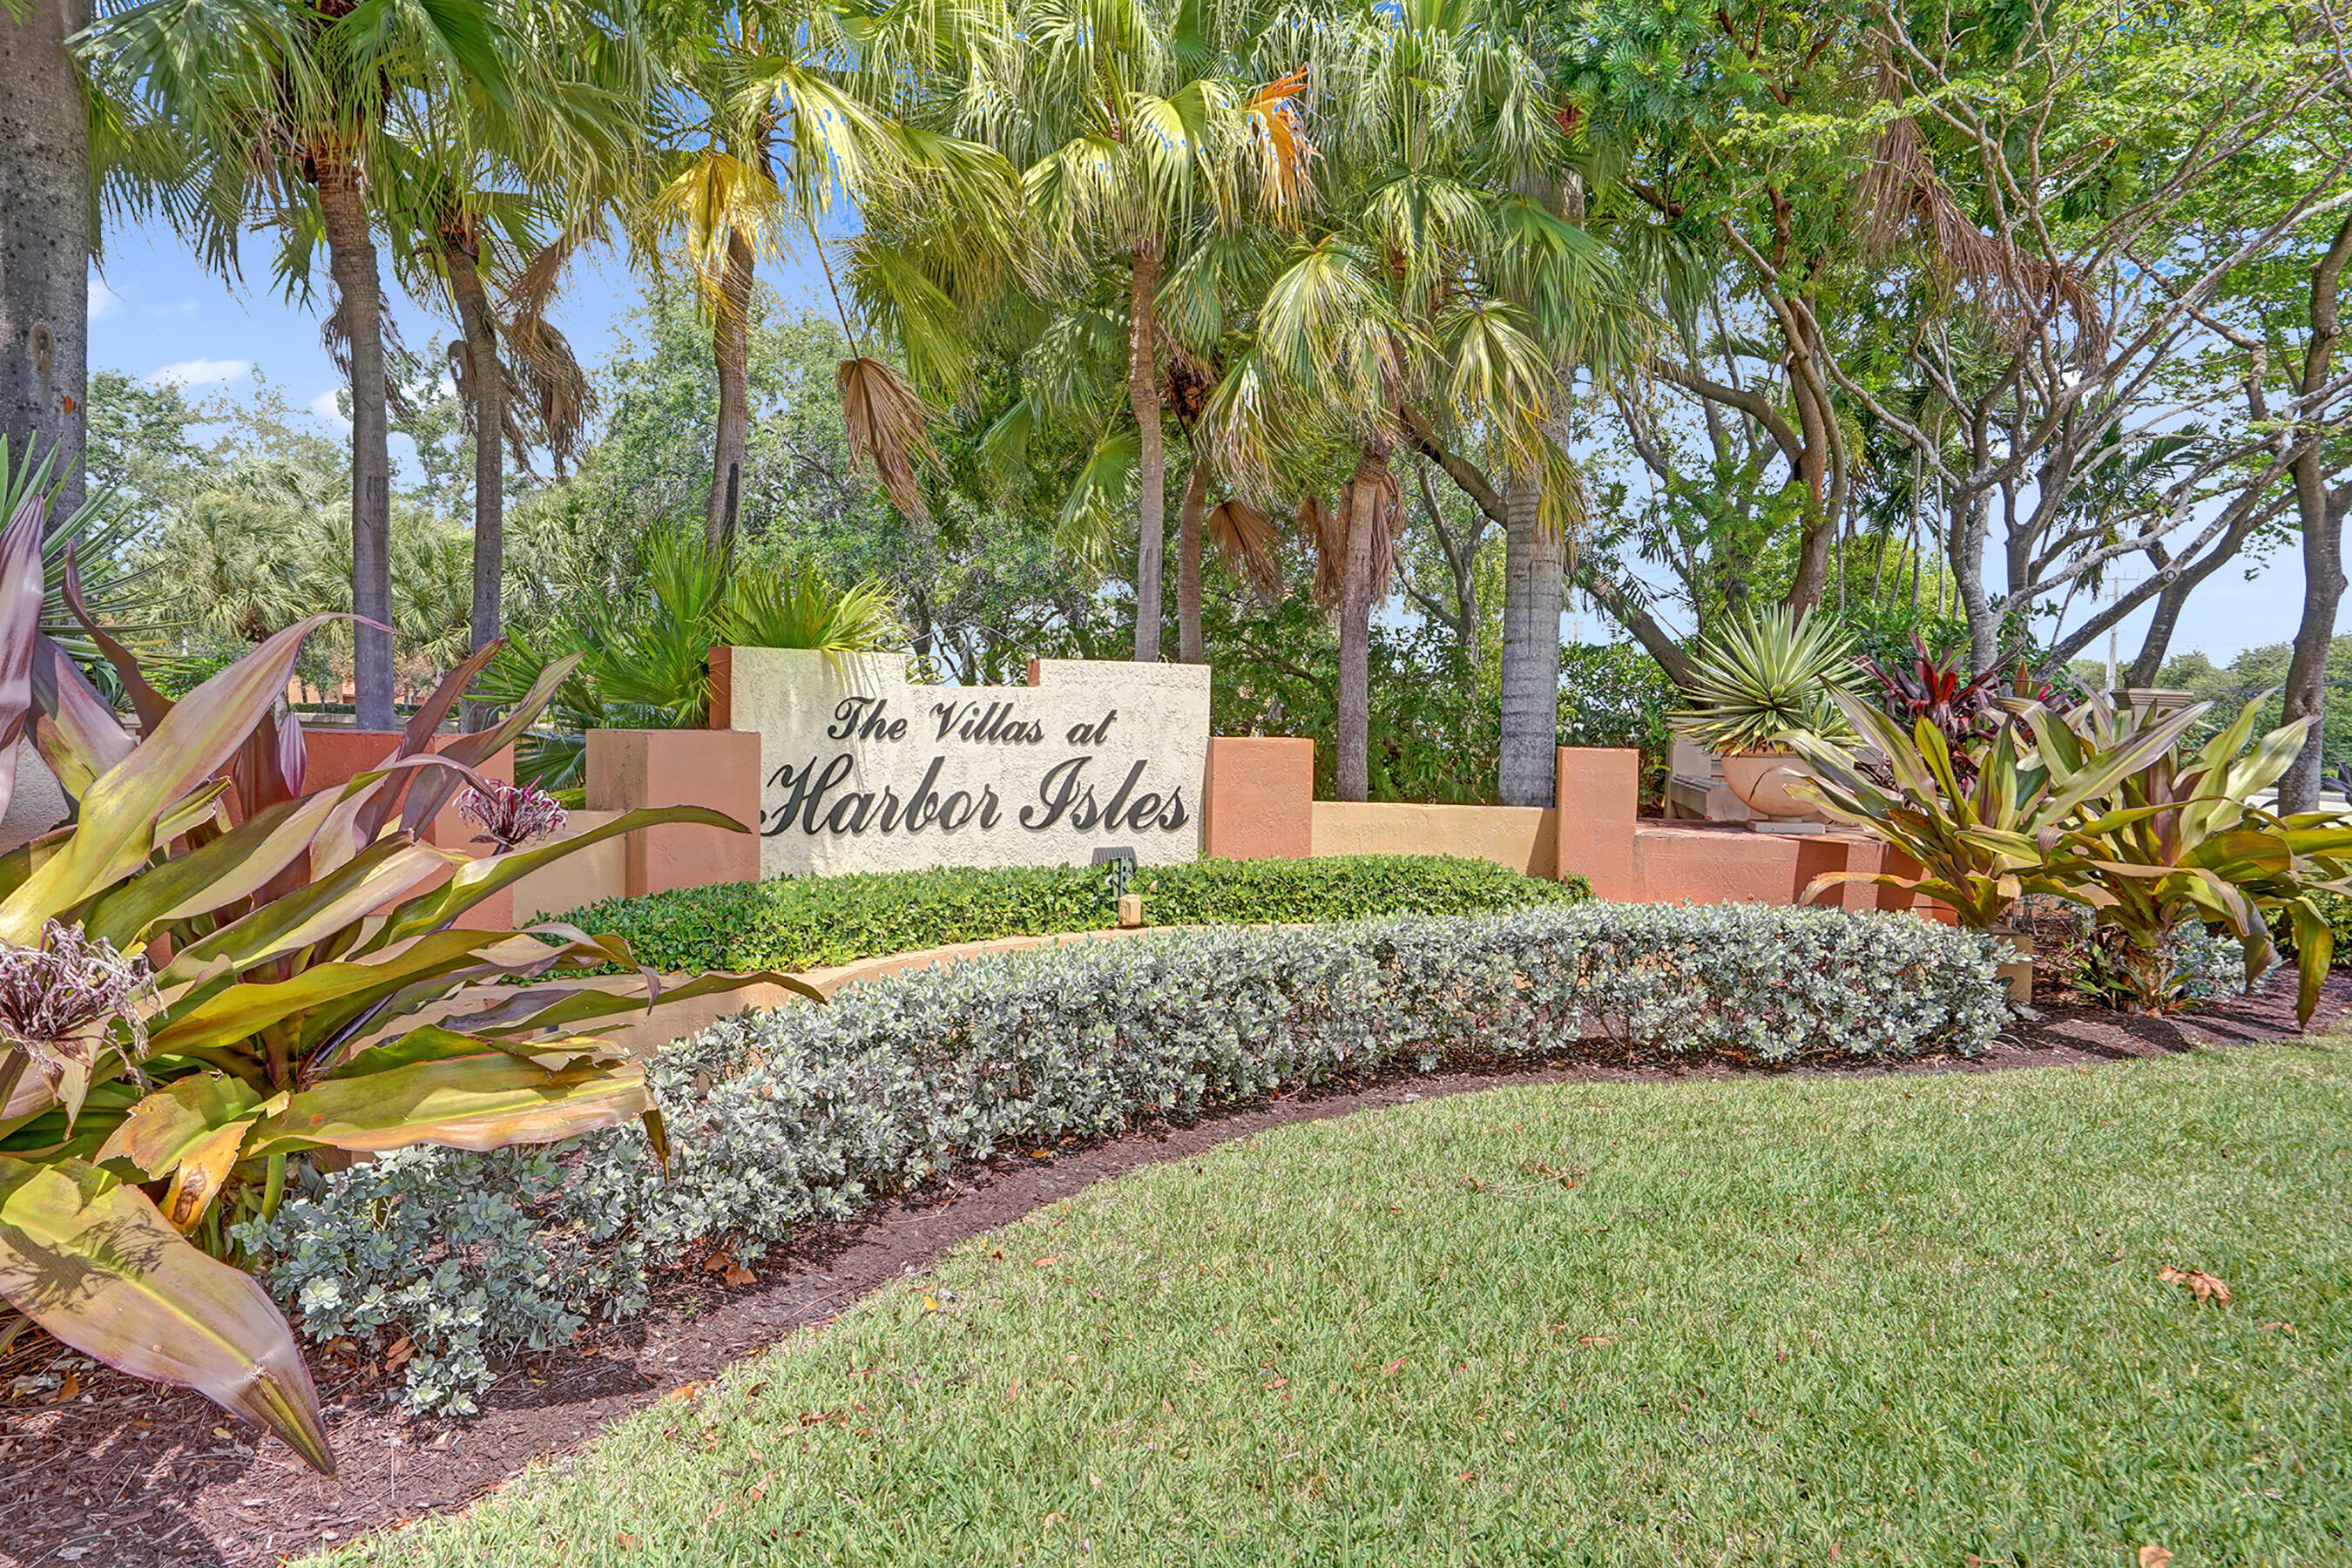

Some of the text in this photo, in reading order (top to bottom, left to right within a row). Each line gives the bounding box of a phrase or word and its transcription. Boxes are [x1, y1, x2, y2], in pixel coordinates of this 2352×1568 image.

[828, 696, 1118, 745] The Villas at
[760, 753, 1190, 837] Harbor Isles
